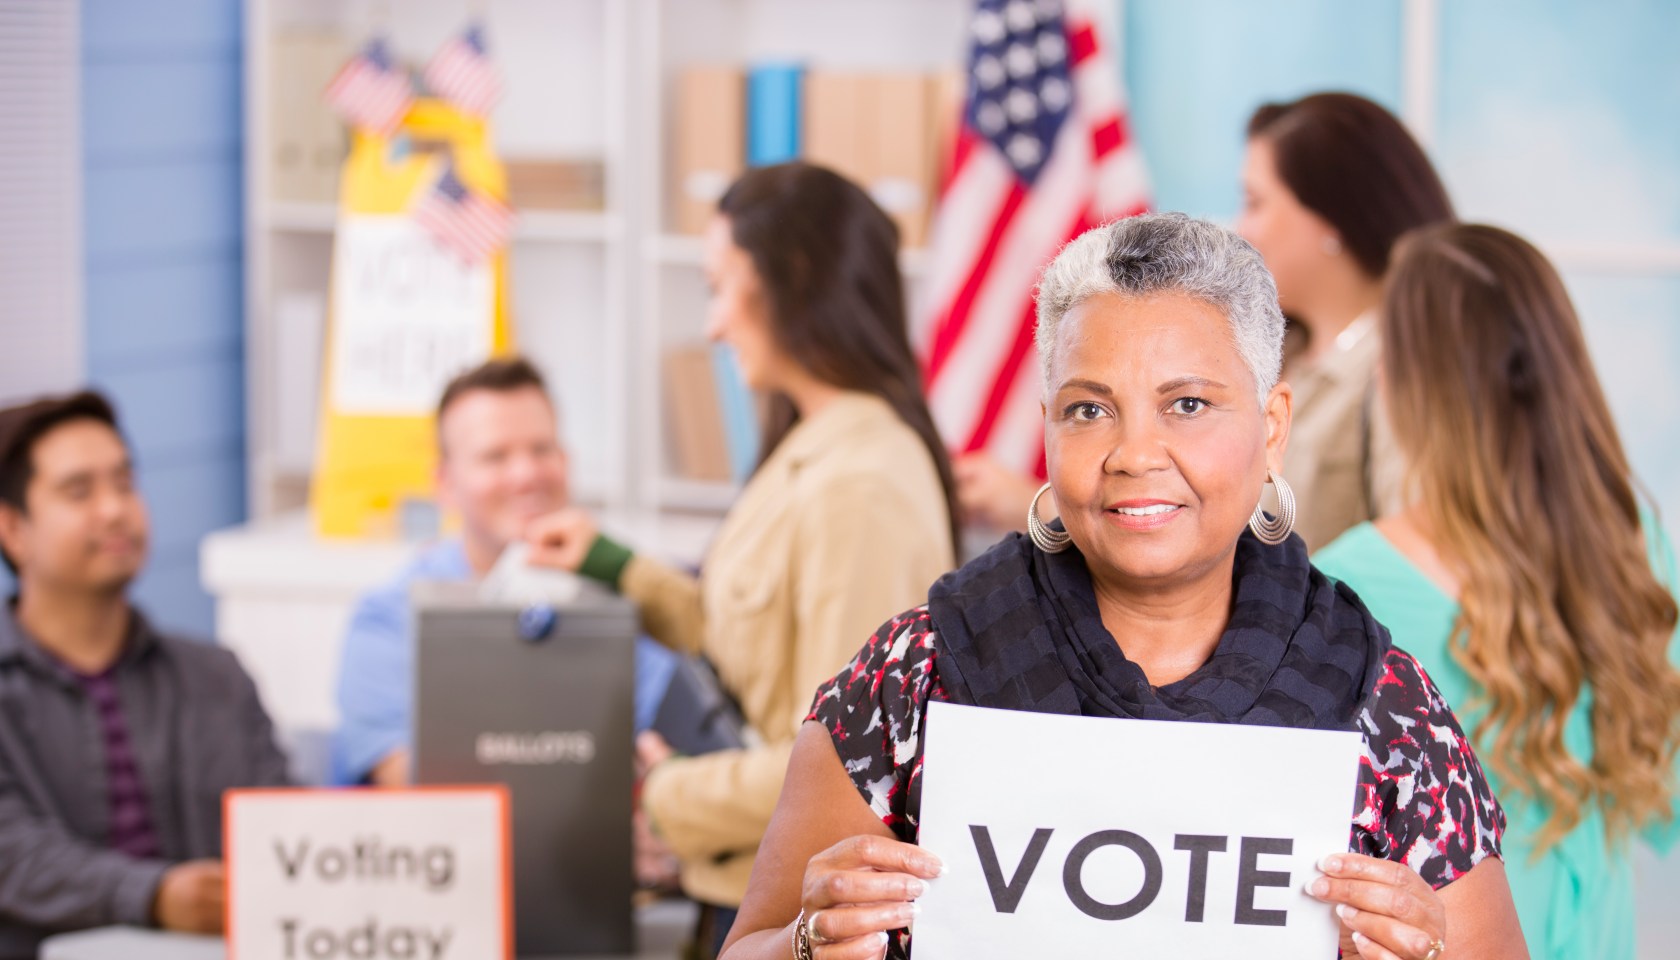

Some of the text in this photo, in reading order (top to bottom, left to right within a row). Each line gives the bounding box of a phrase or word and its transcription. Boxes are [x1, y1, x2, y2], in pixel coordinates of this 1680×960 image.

[272, 835, 456, 893] Voting
[968, 824, 1295, 927] VOTE
[276, 916, 453, 960] Today
